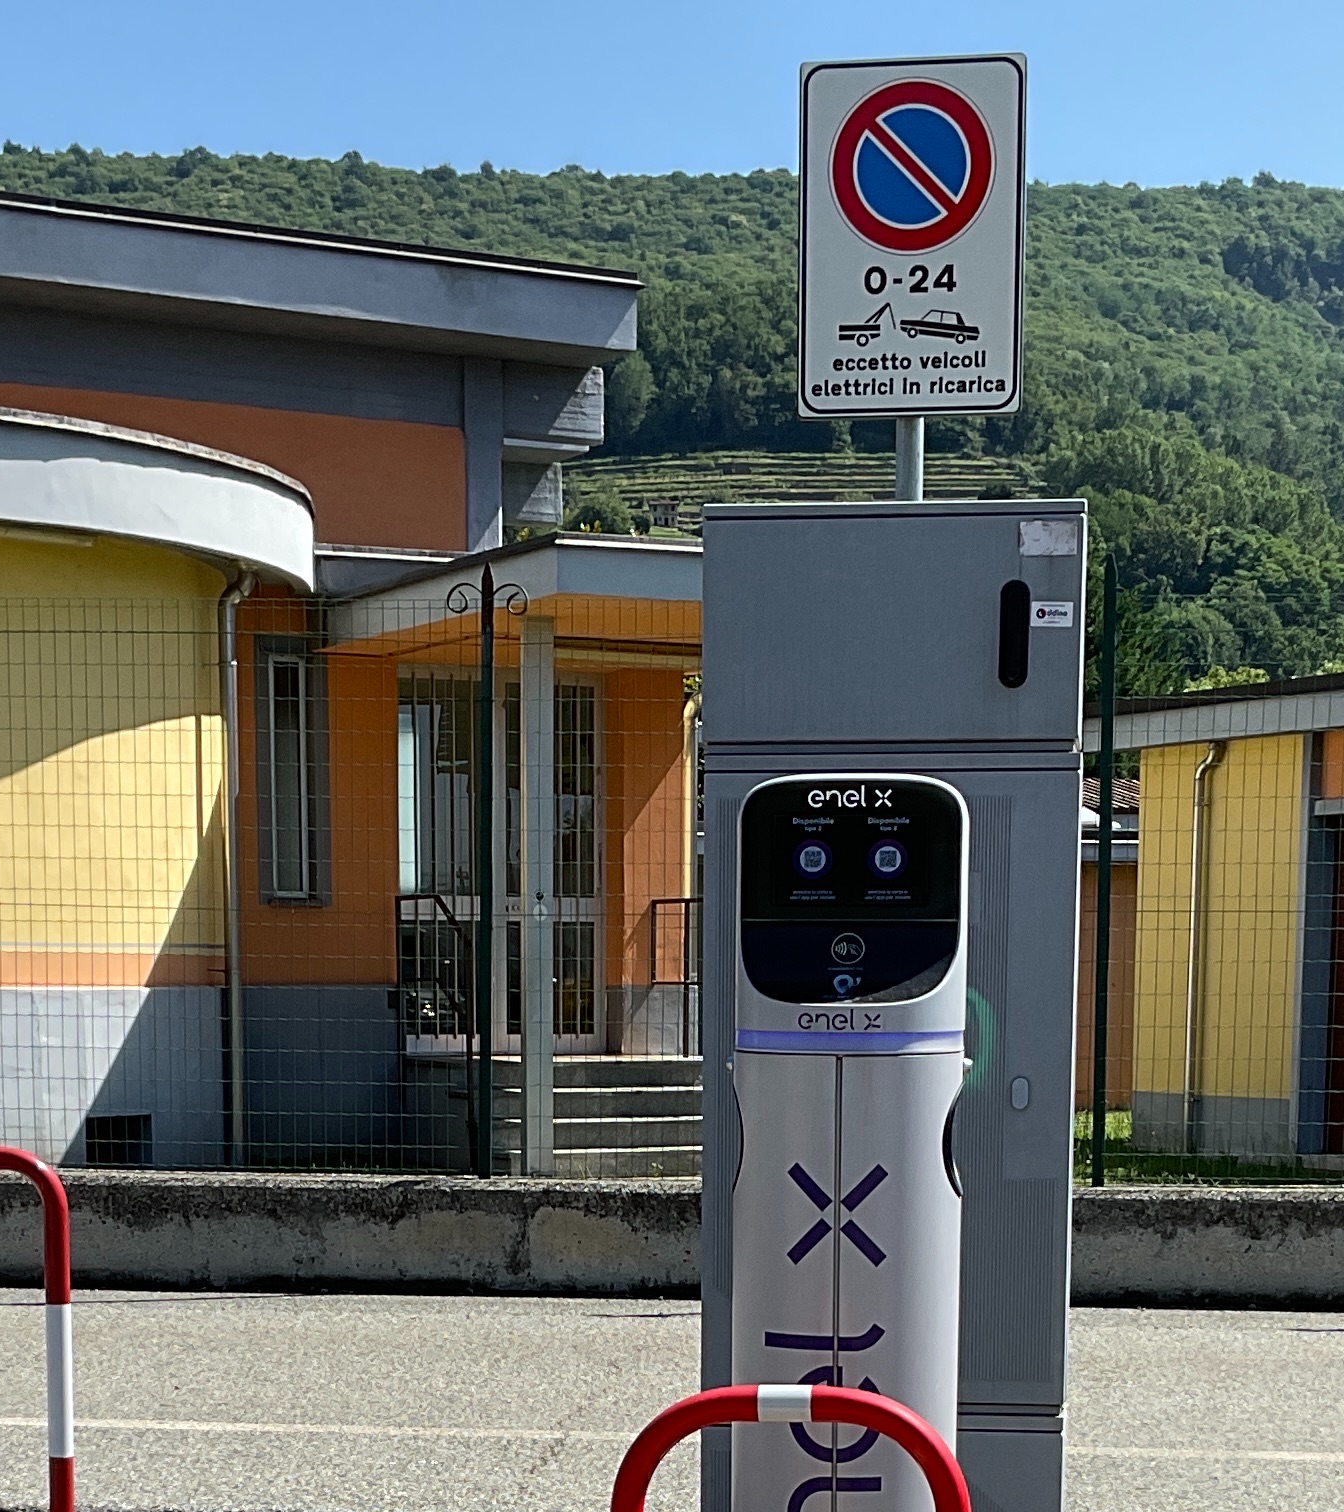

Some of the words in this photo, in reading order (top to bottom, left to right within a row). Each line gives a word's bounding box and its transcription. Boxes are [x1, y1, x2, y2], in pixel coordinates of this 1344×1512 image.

[832, 353, 912, 371] eccetto
[919, 350, 986, 370] veicoli
[811, 378, 894, 397] elettrici
[902, 377, 921, 395] in
[929, 376, 1006, 394] ricarica
[807, 784, 866, 808] enel
[874, 788, 893, 808] x
[797, 1008, 855, 1031] enel
